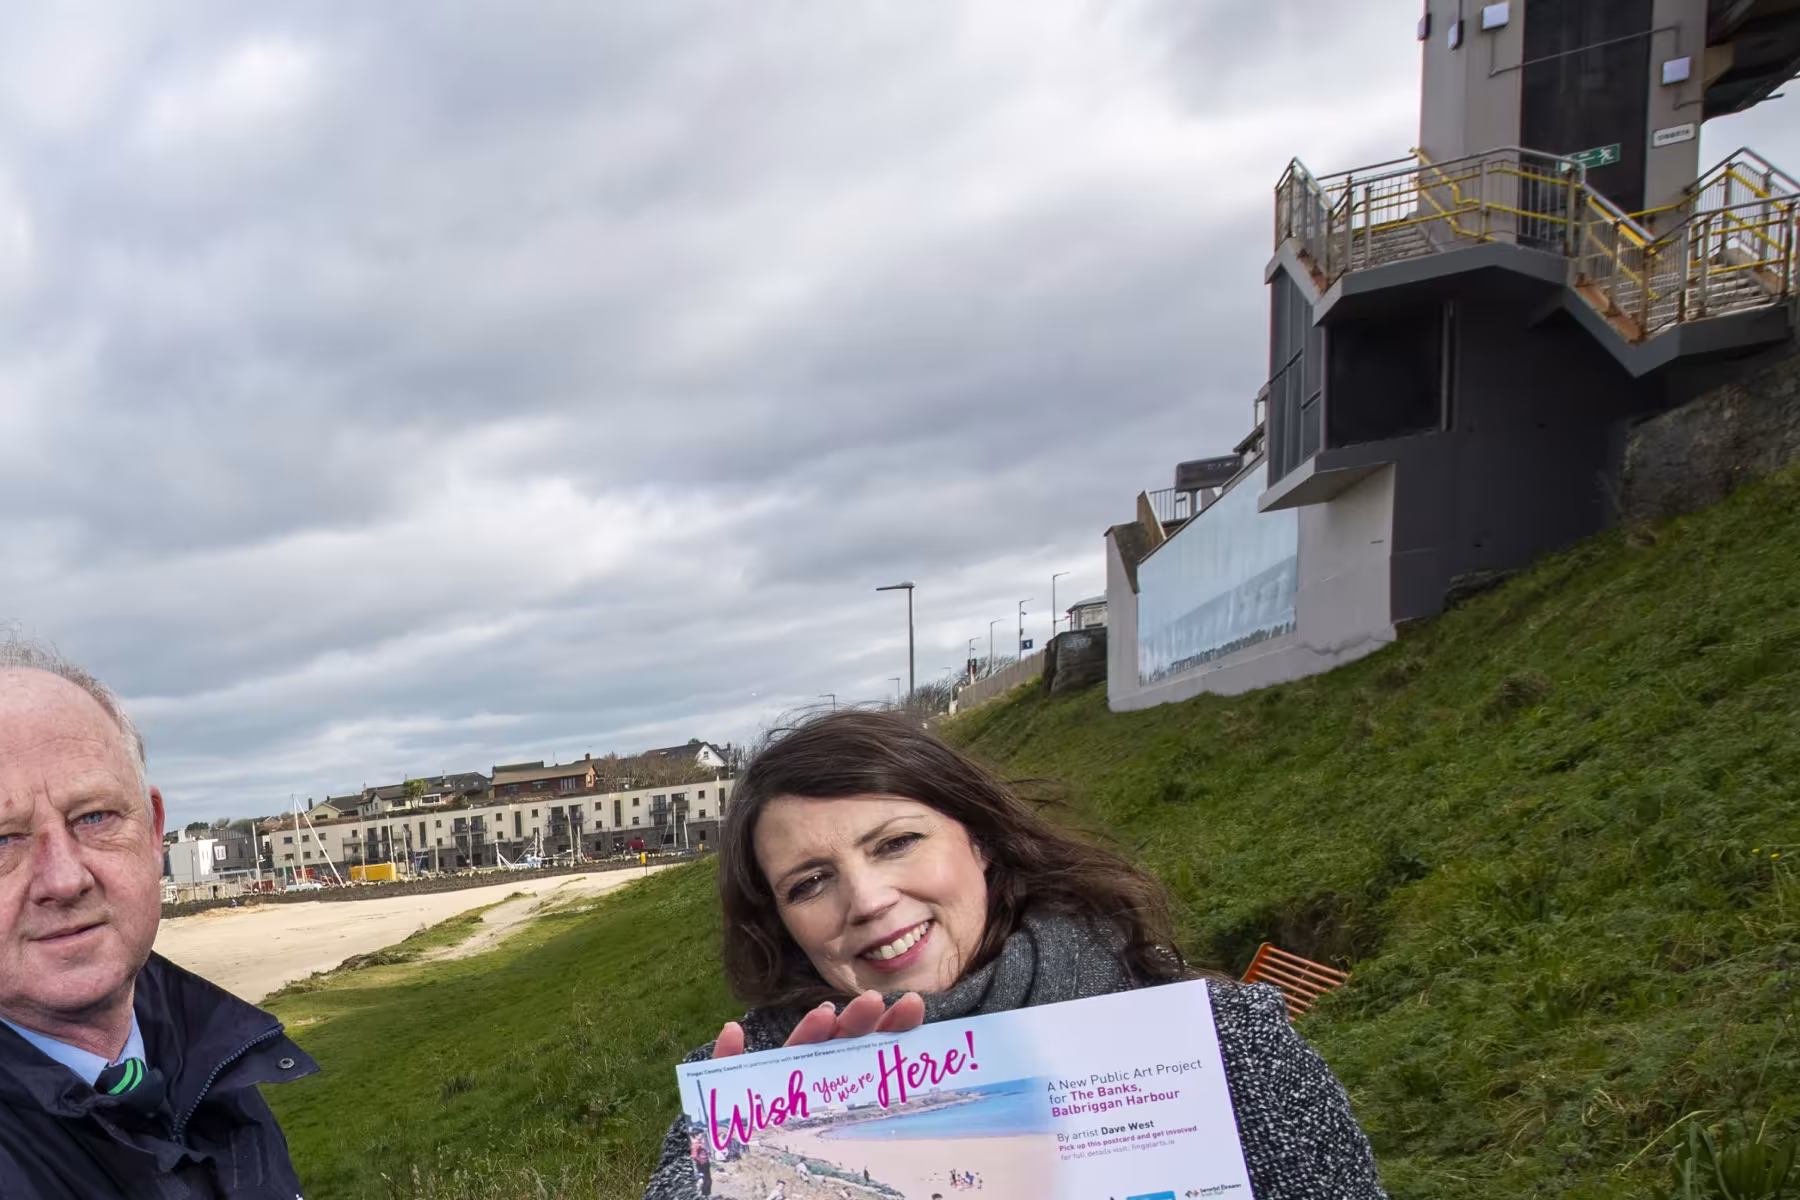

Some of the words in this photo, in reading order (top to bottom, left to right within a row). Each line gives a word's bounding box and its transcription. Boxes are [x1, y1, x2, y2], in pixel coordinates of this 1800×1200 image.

[1047, 1081, 1056, 1093] A
[1059, 1079, 1087, 1091] New
[1090, 1070, 1130, 1086] Public
[1133, 1068, 1153, 1079] Art
[1156, 1059, 1203, 1075] Project
[709, 1069, 810, 1151] Wish
[813, 1073, 848, 1104] You
[878, 1030, 978, 1108] Here!
[1049, 1094, 1067, 1105] for
[1070, 1090, 1094, 1101] The
[1097, 1083, 1142, 1097] Banks,
[1051, 1099, 1123, 1118] Balbriggan
[1126, 1089, 1180, 1106] Harbour
[1057, 1133, 1070, 1143] By
[1072, 1129, 1099, 1140] artist
[1101, 1125, 1126, 1135] Dave
[1128, 1120, 1155, 1131] West
[1059, 1144, 1074, 1152] Pick
[1076, 1143, 1086, 1151] up
[1087, 1140, 1101, 1148] this
[1103, 1136, 1135, 1147] postcard
[1137, 1132, 1151, 1141] and
[1152, 1131, 1164, 1140] get
[1166, 1125, 1198, 1136] involved
[1073, 1151, 1086, 1159] full
[1087, 1148, 1111, 1158] details
